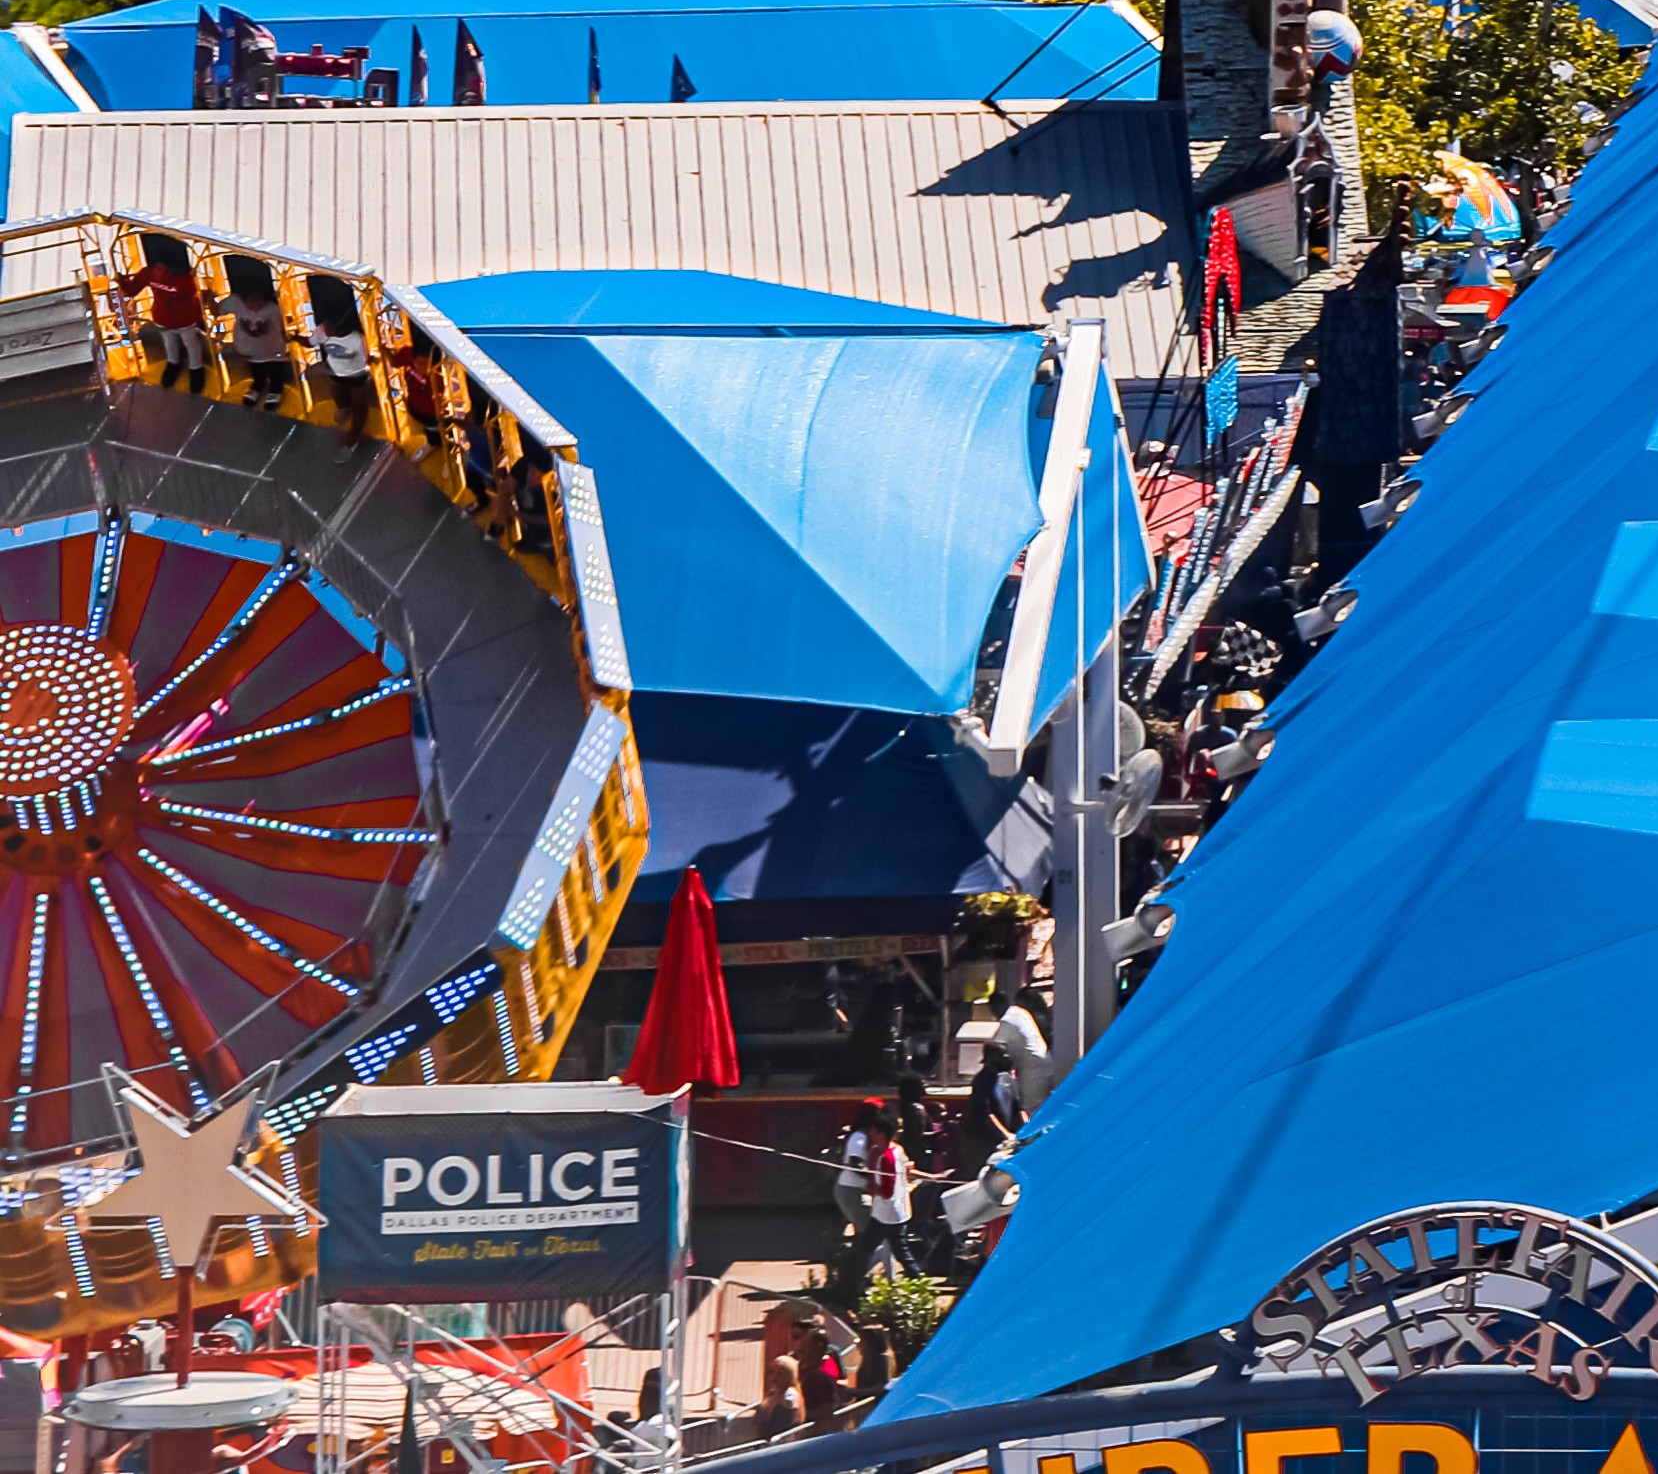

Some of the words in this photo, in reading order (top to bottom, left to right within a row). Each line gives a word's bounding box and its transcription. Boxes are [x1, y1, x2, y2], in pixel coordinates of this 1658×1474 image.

[382, 1147, 640, 1207] POLICE
[385, 1215, 449, 1229] DALLAS
[457, 1213, 518, 1227] POLICE
[525, 1206, 637, 1225] DEPARTMENT
[413, 1241, 468, 1264] State
[472, 1239, 518, 1260] Fair
[543, 1235, 601, 1257] Texas
[1251, 1214, 1501, 1373] STATE
[1443, 1271, 1485, 1310] of
[1316, 1311, 1614, 1408] TEXAS
